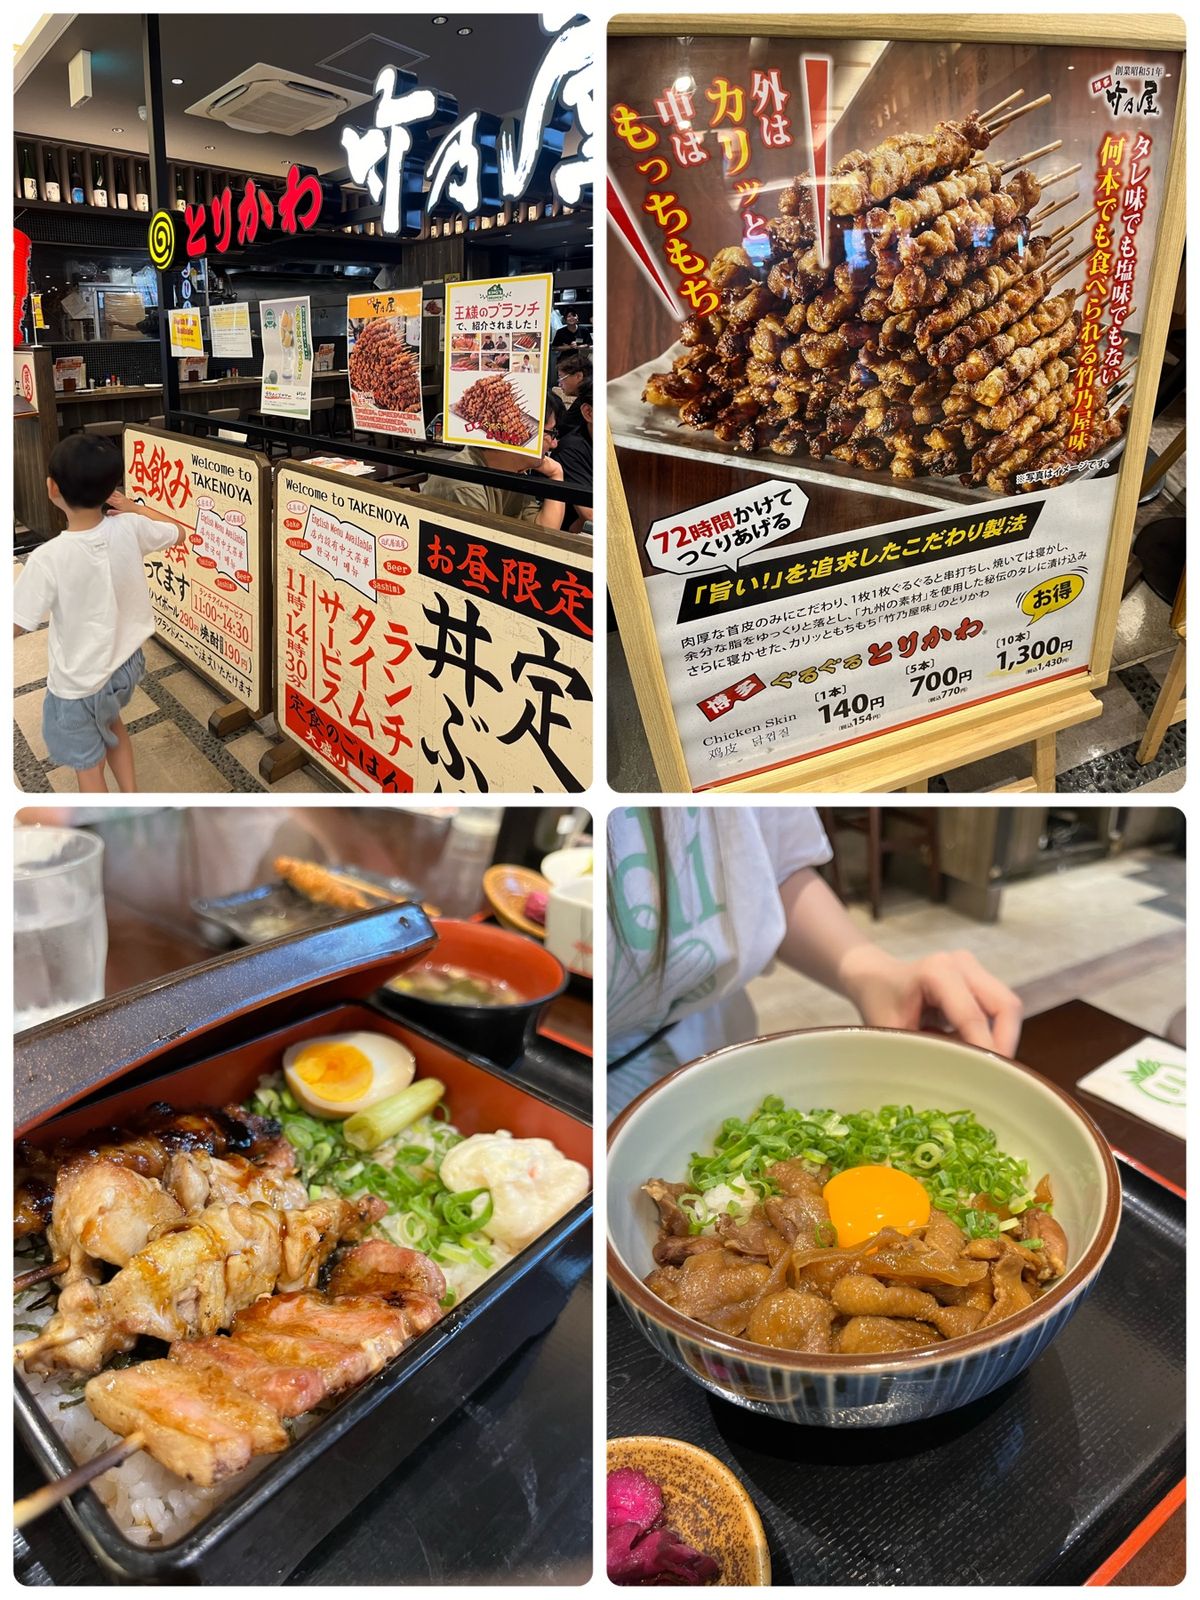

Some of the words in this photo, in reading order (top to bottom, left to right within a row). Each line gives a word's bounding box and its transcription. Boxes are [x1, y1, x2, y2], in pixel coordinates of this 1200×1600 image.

[1106, 80, 1158, 116] 竹乃屋
[1115, 65, 1163, 77] 創業昭和51年
[656, 90, 708, 166] 中は
[752, 70, 793, 146] 外は
[707, 78, 769, 241] カリッと
[185, 164, 323, 258] とりかわ
[612, 105, 720, 317] もっちもち
[1101, 135, 1151, 384] タレ味でも塩味でもない
[454, 301, 540, 320] 王様のブランチ
[1068, 136, 1126, 451] 何本でも食べられる竹乃屋味
[457, 320, 538, 331] で、紹介されました!
[128, 440, 193, 511] 昼飲み
[191, 453, 235, 476] Welcome
[238, 467, 252, 482] to
[191, 471, 252, 505] TAKENOYA
[1016, 458, 1110, 484] ※写真はイメージです。
[286, 478, 328, 501] Welcome
[332, 493, 345, 507] to
[347, 497, 409, 529] TAKENOYA
[311, 513, 329, 531] English
[330, 523, 343, 538] Menu
[345, 532, 373, 553] Available
[652, 488, 793, 554] 72時間かけて
[387, 562, 408, 574] Beer
[677, 512, 791, 566] つくりあげる
[694, 513, 1028, 605] 「旨い!」を追求したこだわり製法
[372, 580, 401, 594] Sashimi
[427, 534, 593, 636] お昼限定
[1033, 581, 1072, 609] お得
[318, 588, 345, 719] サービス
[349, 604, 376, 740] タイム
[706, 679, 757, 714] 博多
[771, 653, 863, 690] ぐるぐる
[867, 616, 984, 667] とりかわ
[910, 666, 973, 698] 700円
[996, 636, 1074, 672] 1,300円
[380, 620, 414, 757] ランチ
[415, 591, 504, 793] 丼ぶ
[496, 627, 593, 793] 定
[818, 693, 885, 725] 140円
[702, 720, 762, 748] Chicken
[765, 713, 798, 728] Skin
